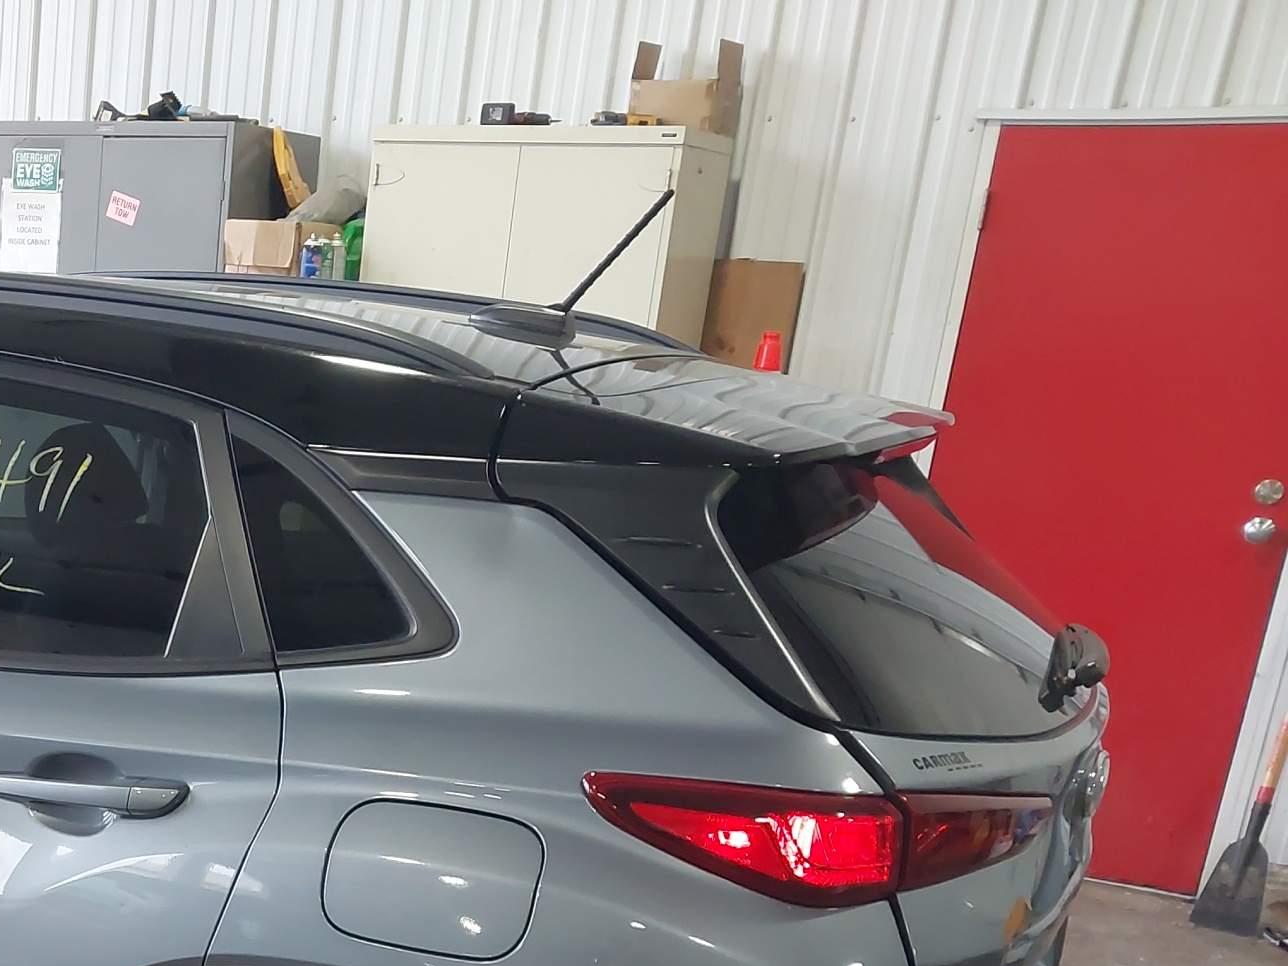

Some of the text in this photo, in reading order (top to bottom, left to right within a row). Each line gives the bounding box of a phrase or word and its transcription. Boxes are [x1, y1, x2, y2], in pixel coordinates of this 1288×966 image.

[16, 152, 58, 163] EMERGENCY
[16, 163, 41, 178] EYE
[16, 178, 41, 187] WASH
[111, 196, 138, 213] RETURN
[114, 207, 129, 219] TOW
[8, 238, 50, 246] INSIDE CABINET
